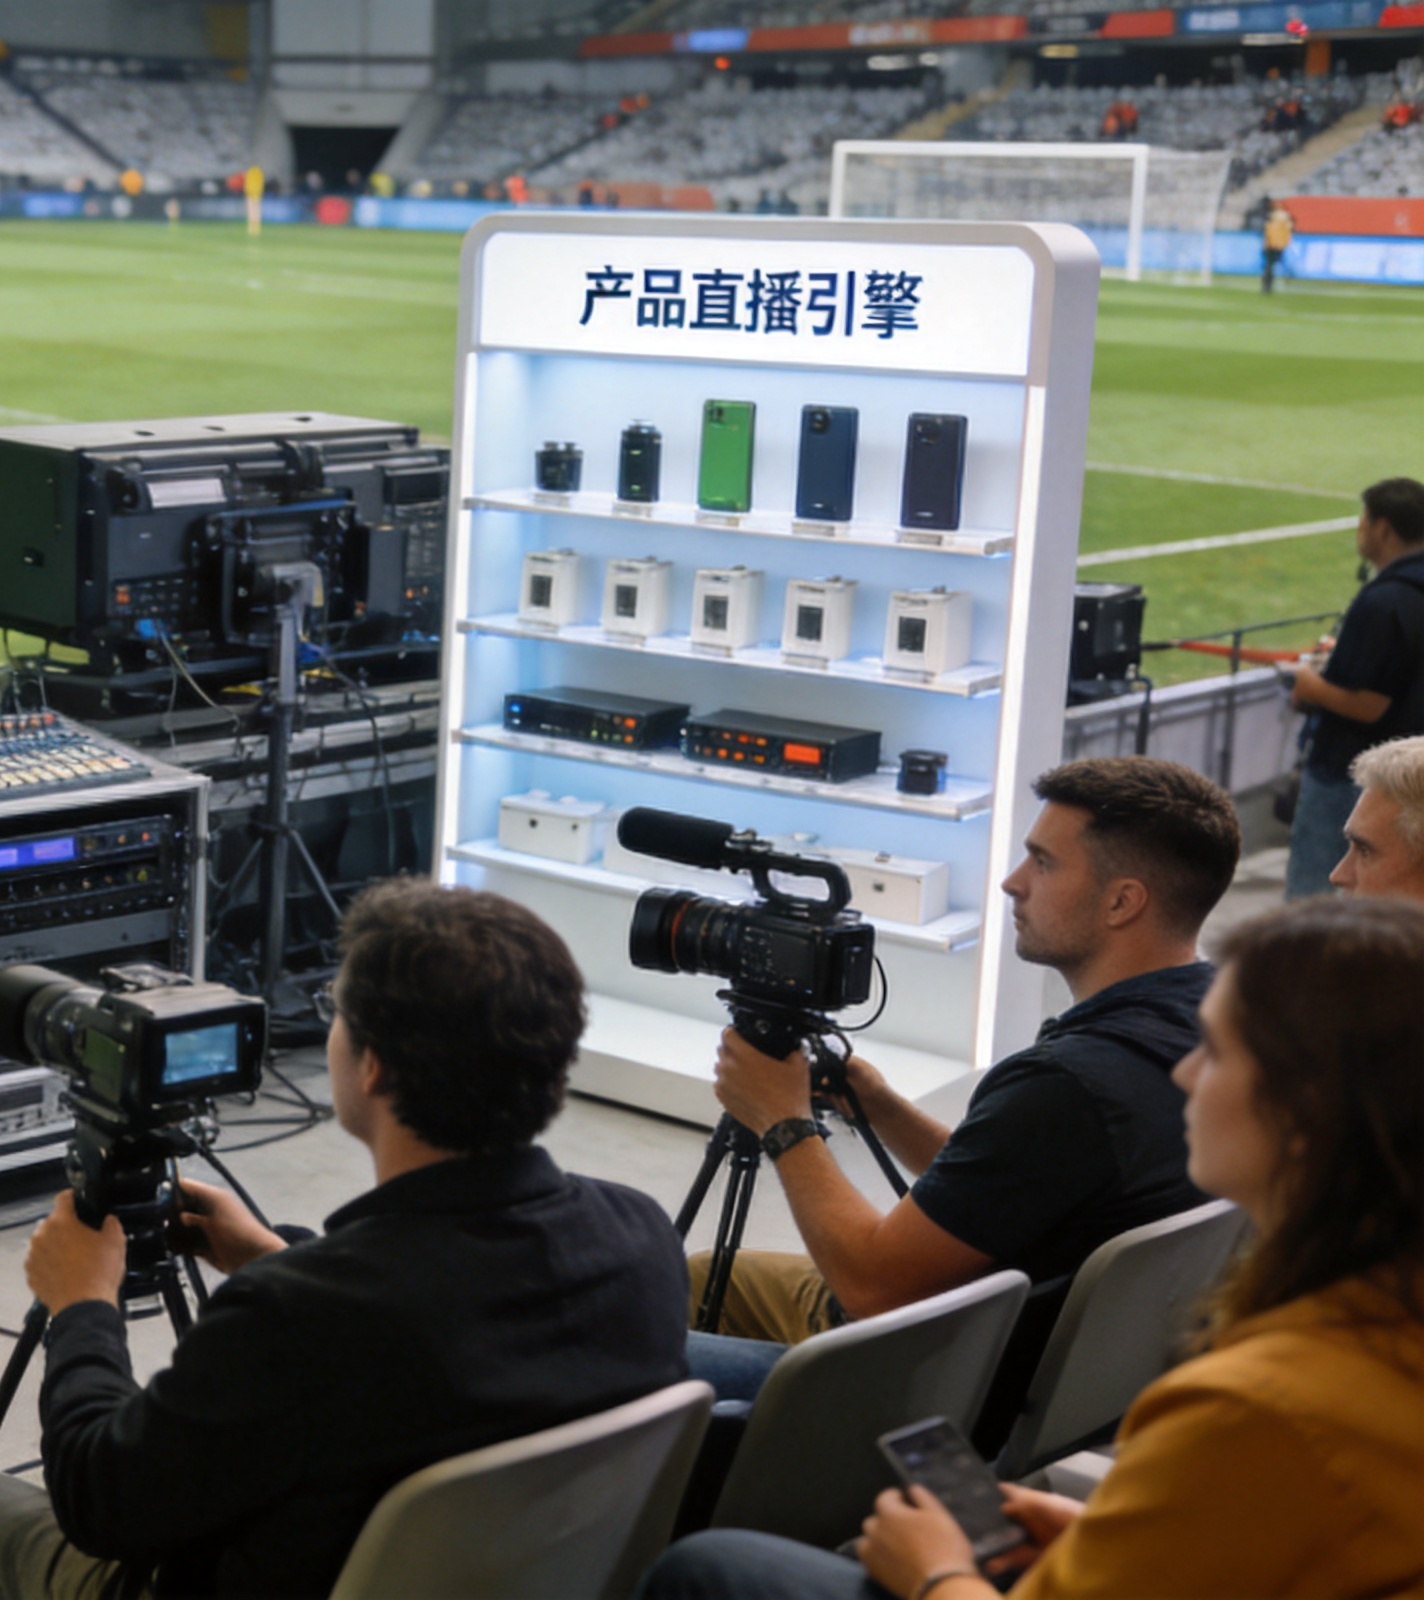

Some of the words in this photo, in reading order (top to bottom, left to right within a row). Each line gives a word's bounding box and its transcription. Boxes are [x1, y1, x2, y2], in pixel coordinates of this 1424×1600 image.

[579, 265, 923, 339] 产品直播引擎
